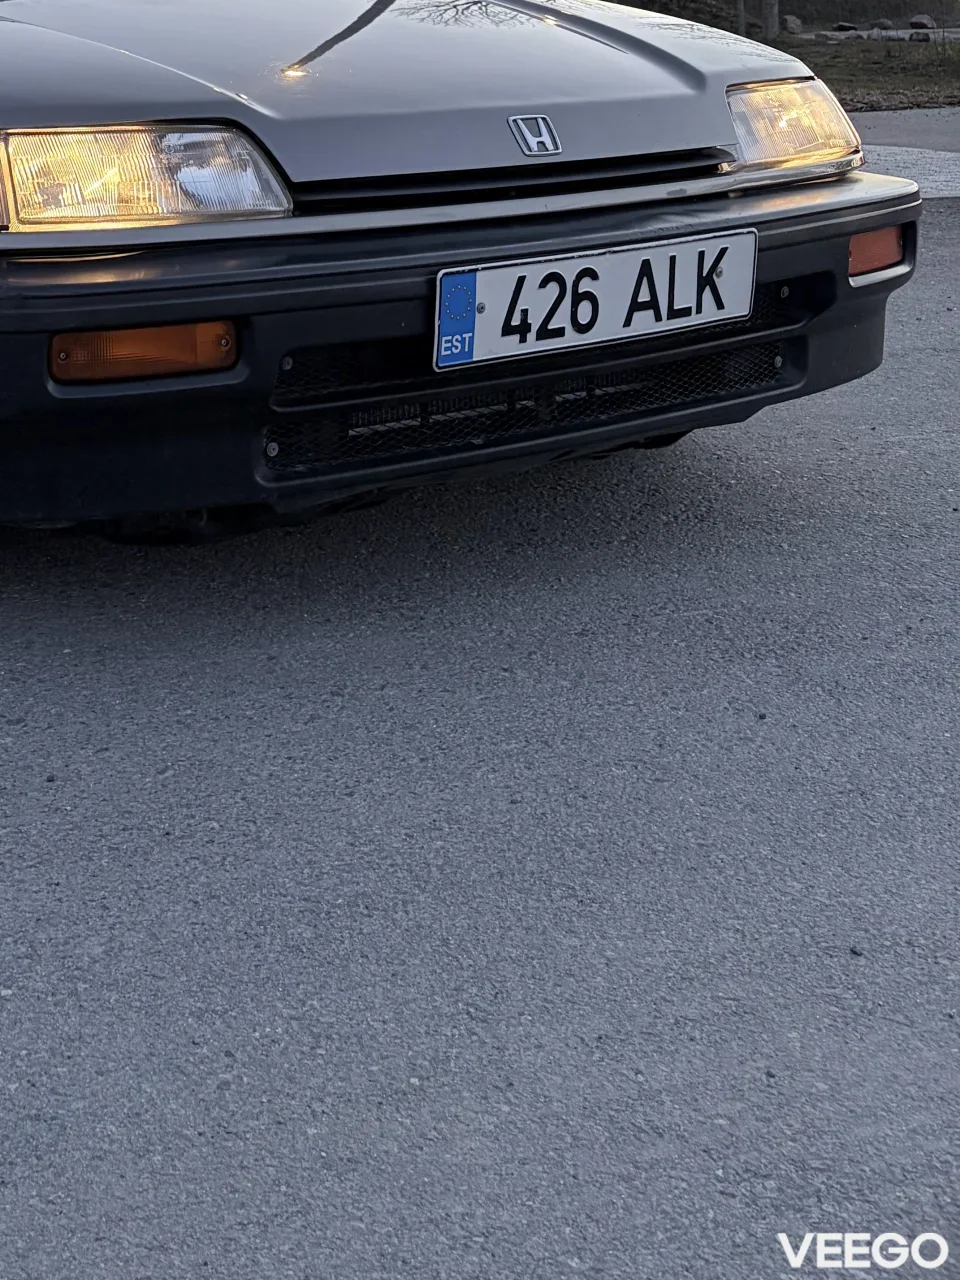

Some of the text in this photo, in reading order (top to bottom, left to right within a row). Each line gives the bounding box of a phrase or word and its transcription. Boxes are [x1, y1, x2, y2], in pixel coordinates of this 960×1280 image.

[501, 246, 730, 344] 426 ALK
[441, 332, 473, 356] EST
